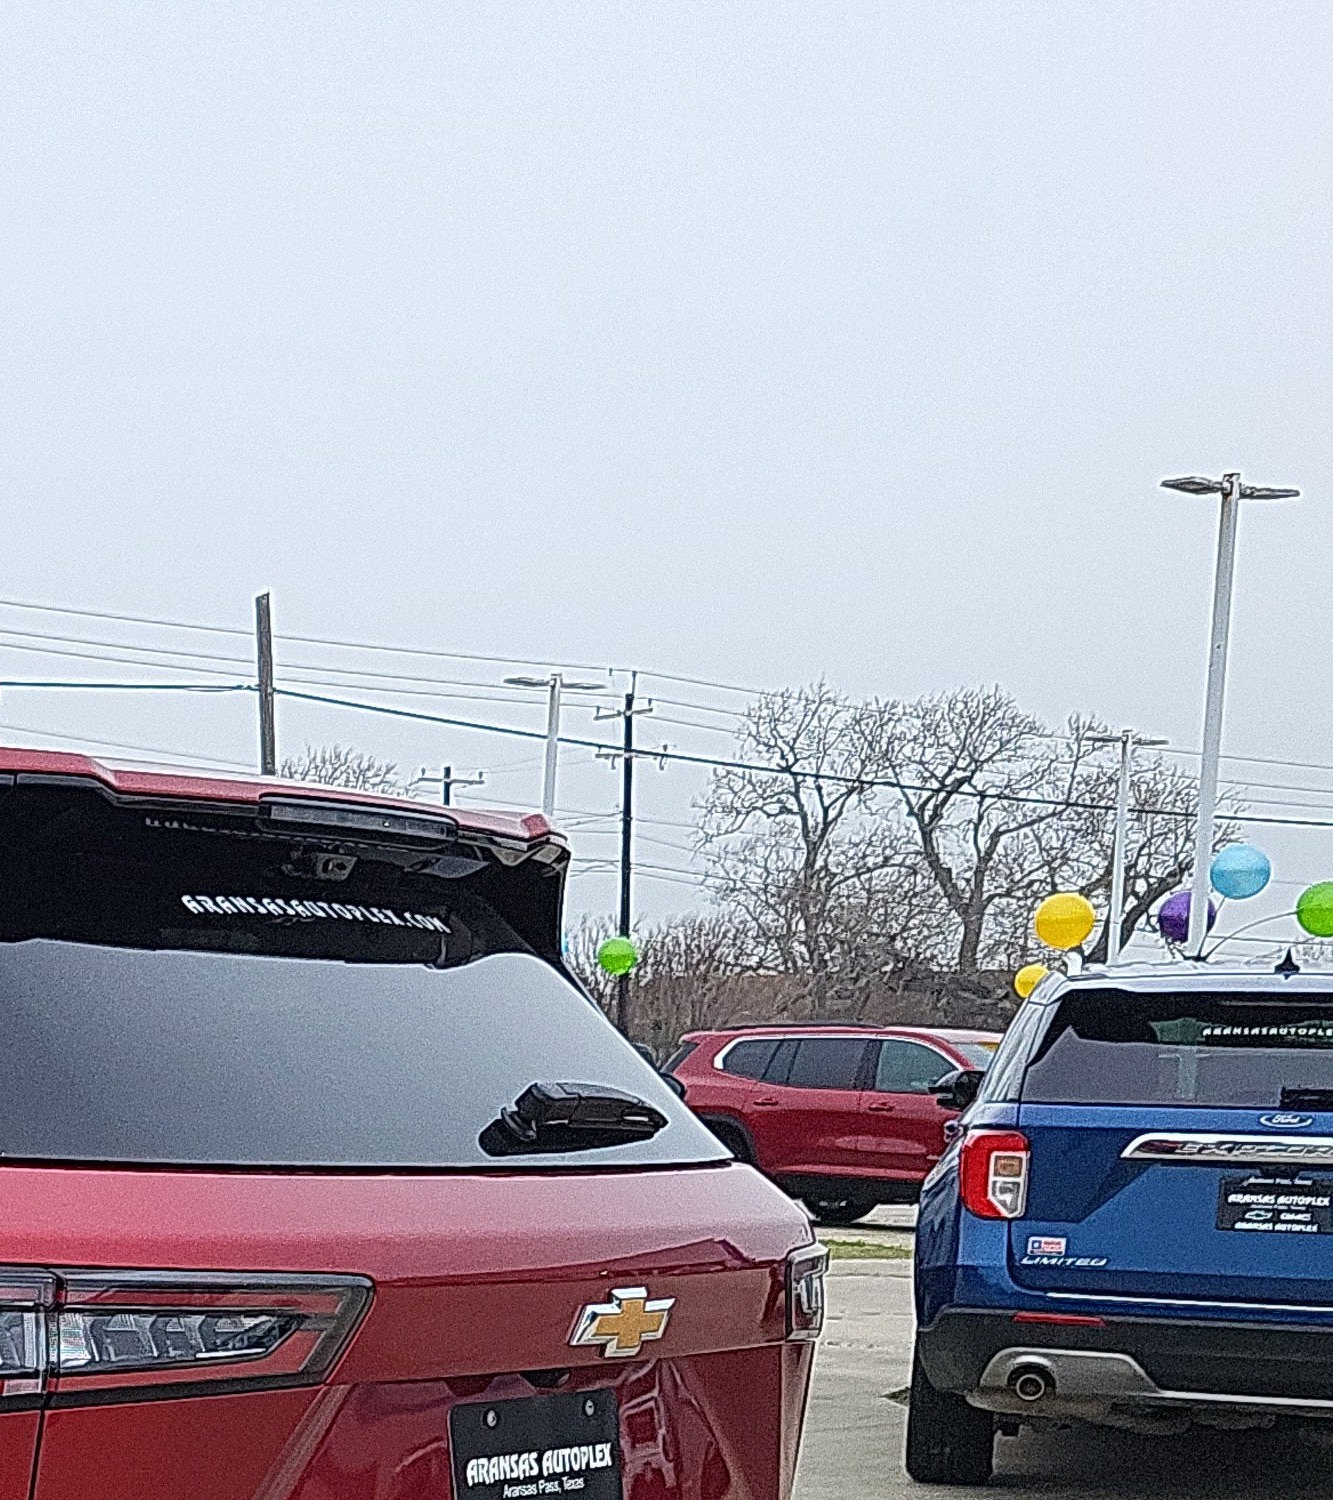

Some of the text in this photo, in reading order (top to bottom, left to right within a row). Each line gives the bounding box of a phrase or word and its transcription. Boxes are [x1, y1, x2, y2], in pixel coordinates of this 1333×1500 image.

[181, 895, 452, 934] ARANSASAUTOPLEX.COM
[1020, 1256, 1108, 1266] LIMITED
[466, 1442, 613, 1487] ARANSAS AUTOPLEX
[502, 1476, 585, 1499] Aransas Pass, Texas
